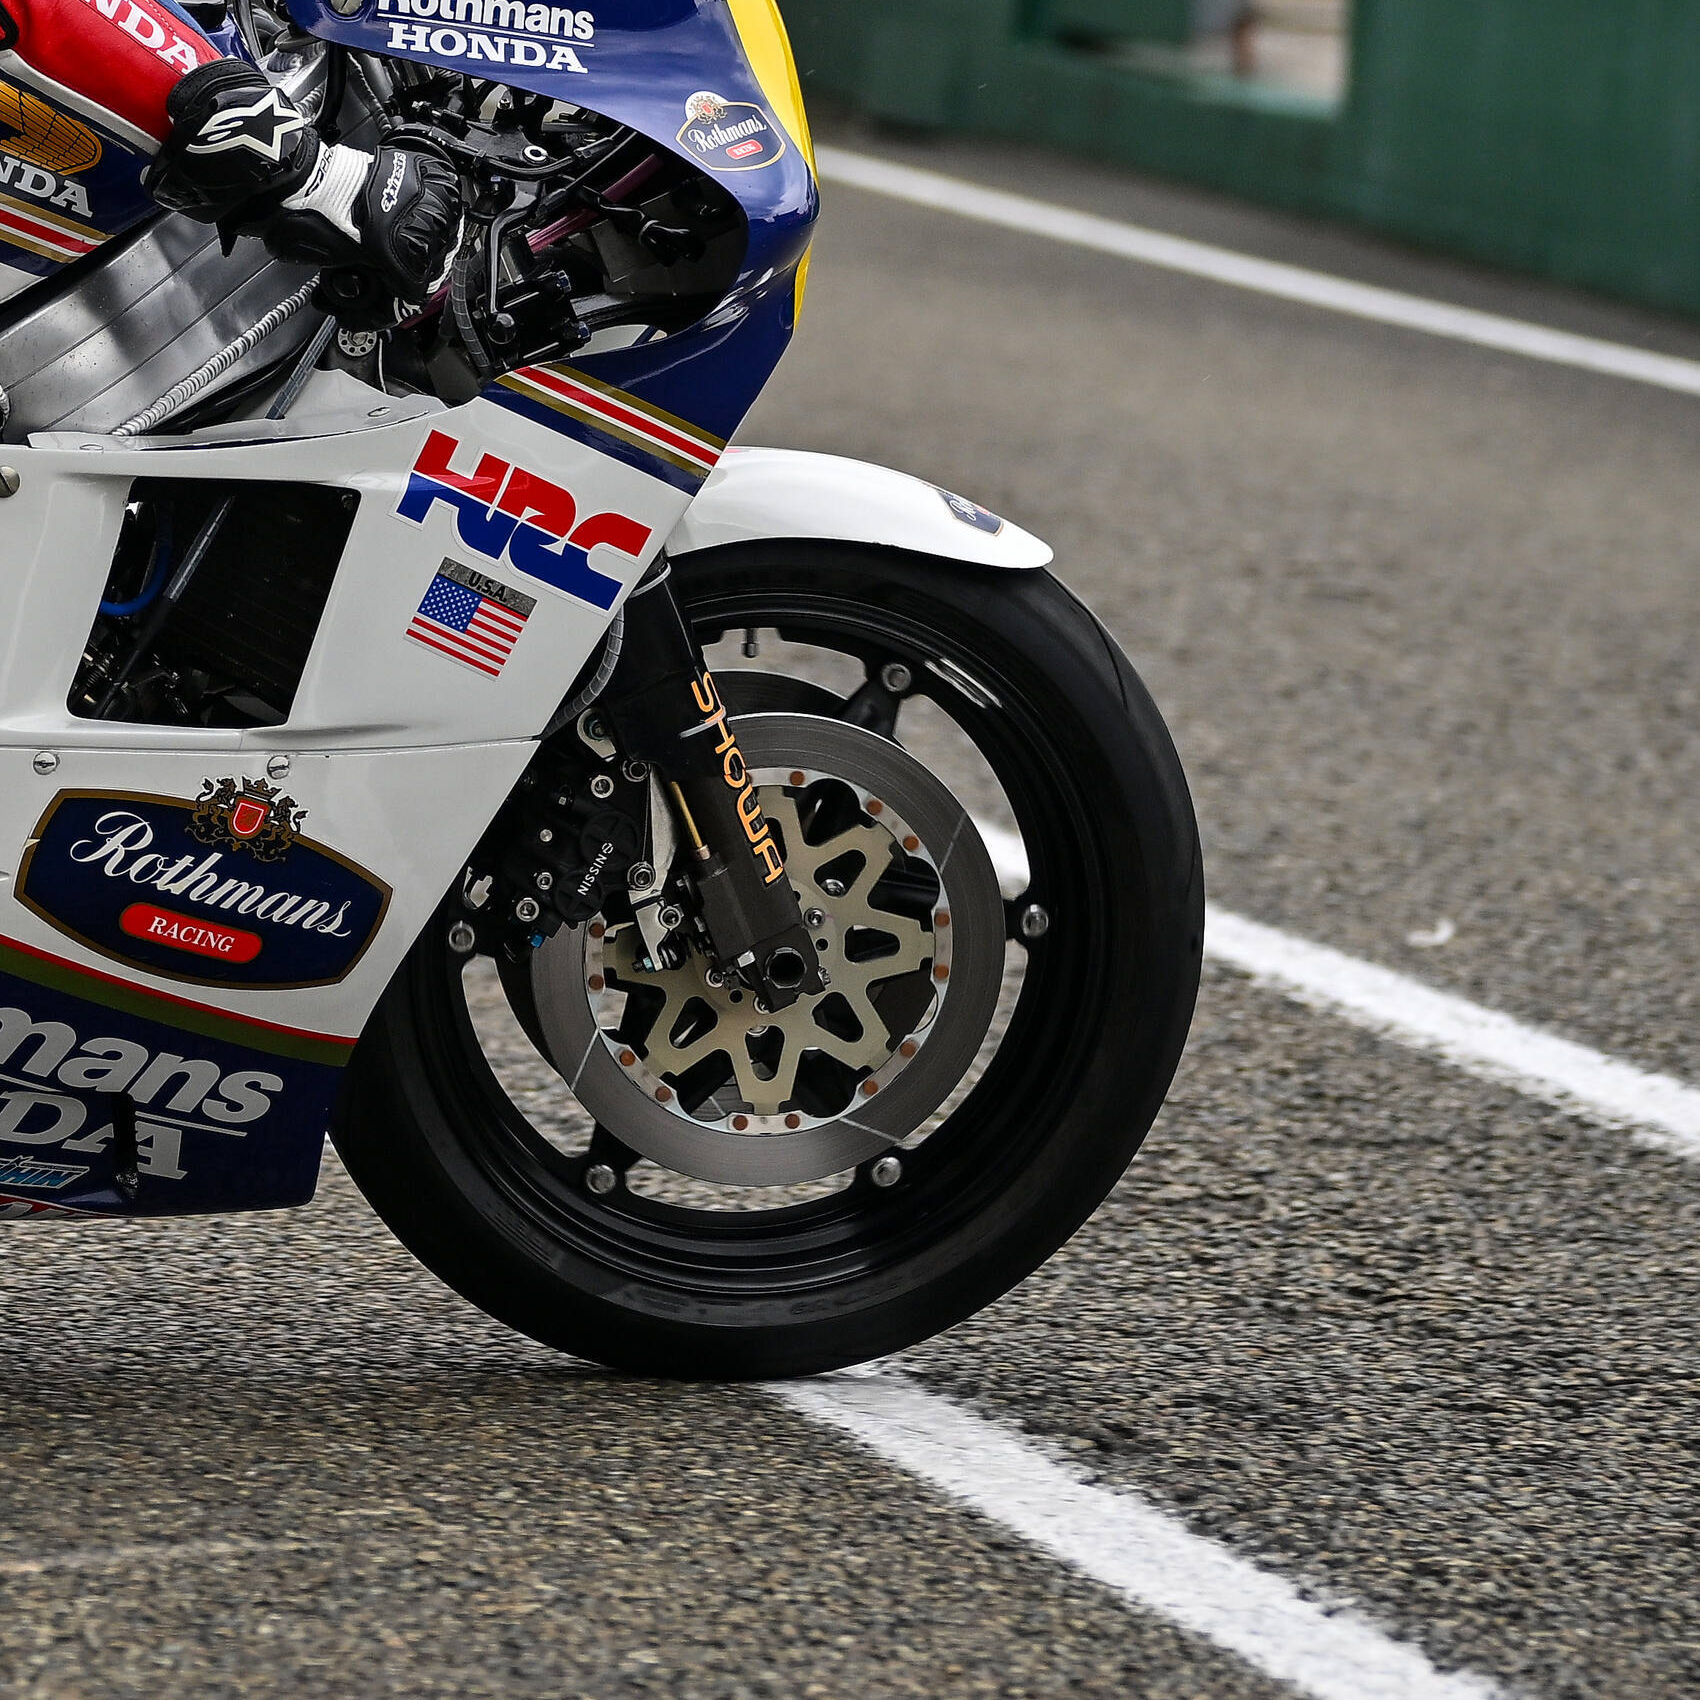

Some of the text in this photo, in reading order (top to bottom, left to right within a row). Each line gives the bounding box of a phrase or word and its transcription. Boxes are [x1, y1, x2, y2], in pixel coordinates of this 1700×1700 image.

[385, 22, 588, 74] HONDA
[687, 114, 768, 154] Rothmans
[395, 428, 653, 612] HRC
[690, 670, 784, 884] SHOWA
[70, 810, 352, 938] Rothmans
[577, 852, 610, 897] NISSIN
[146, 915, 238, 954] RACING
